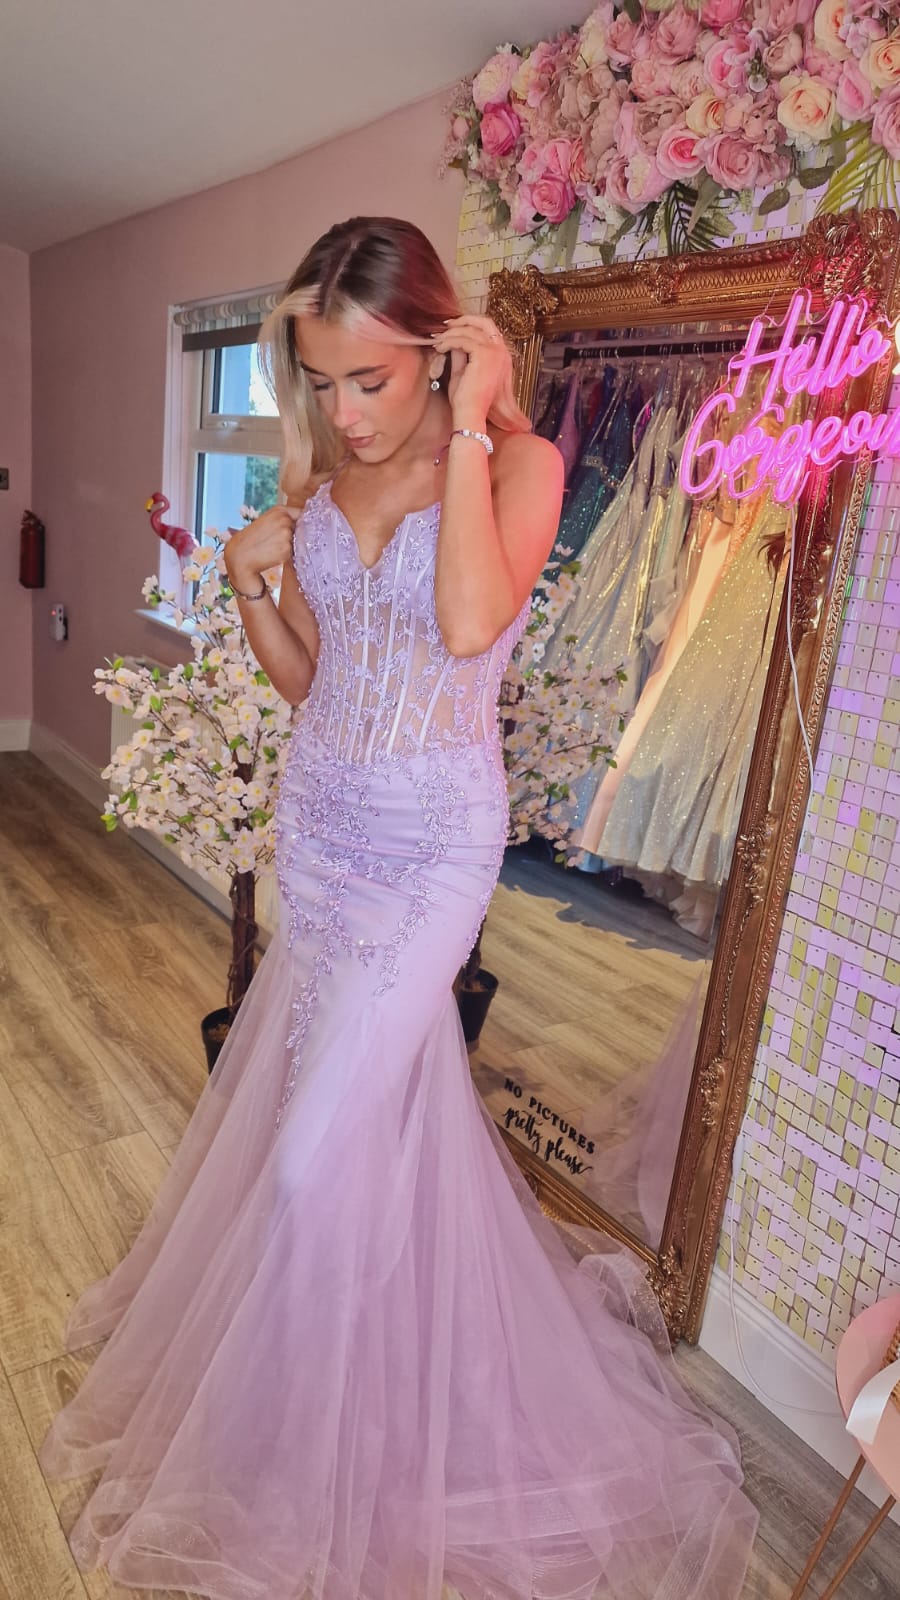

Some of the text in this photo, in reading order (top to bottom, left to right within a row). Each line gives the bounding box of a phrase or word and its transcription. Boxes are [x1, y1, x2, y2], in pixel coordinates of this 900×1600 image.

[730, 294, 892, 411] Hello
[680, 392, 900, 503] Gorgeou
[502, 1107, 593, 1175] pretty please
[504, 1078, 595, 1154] NO PICTURES
